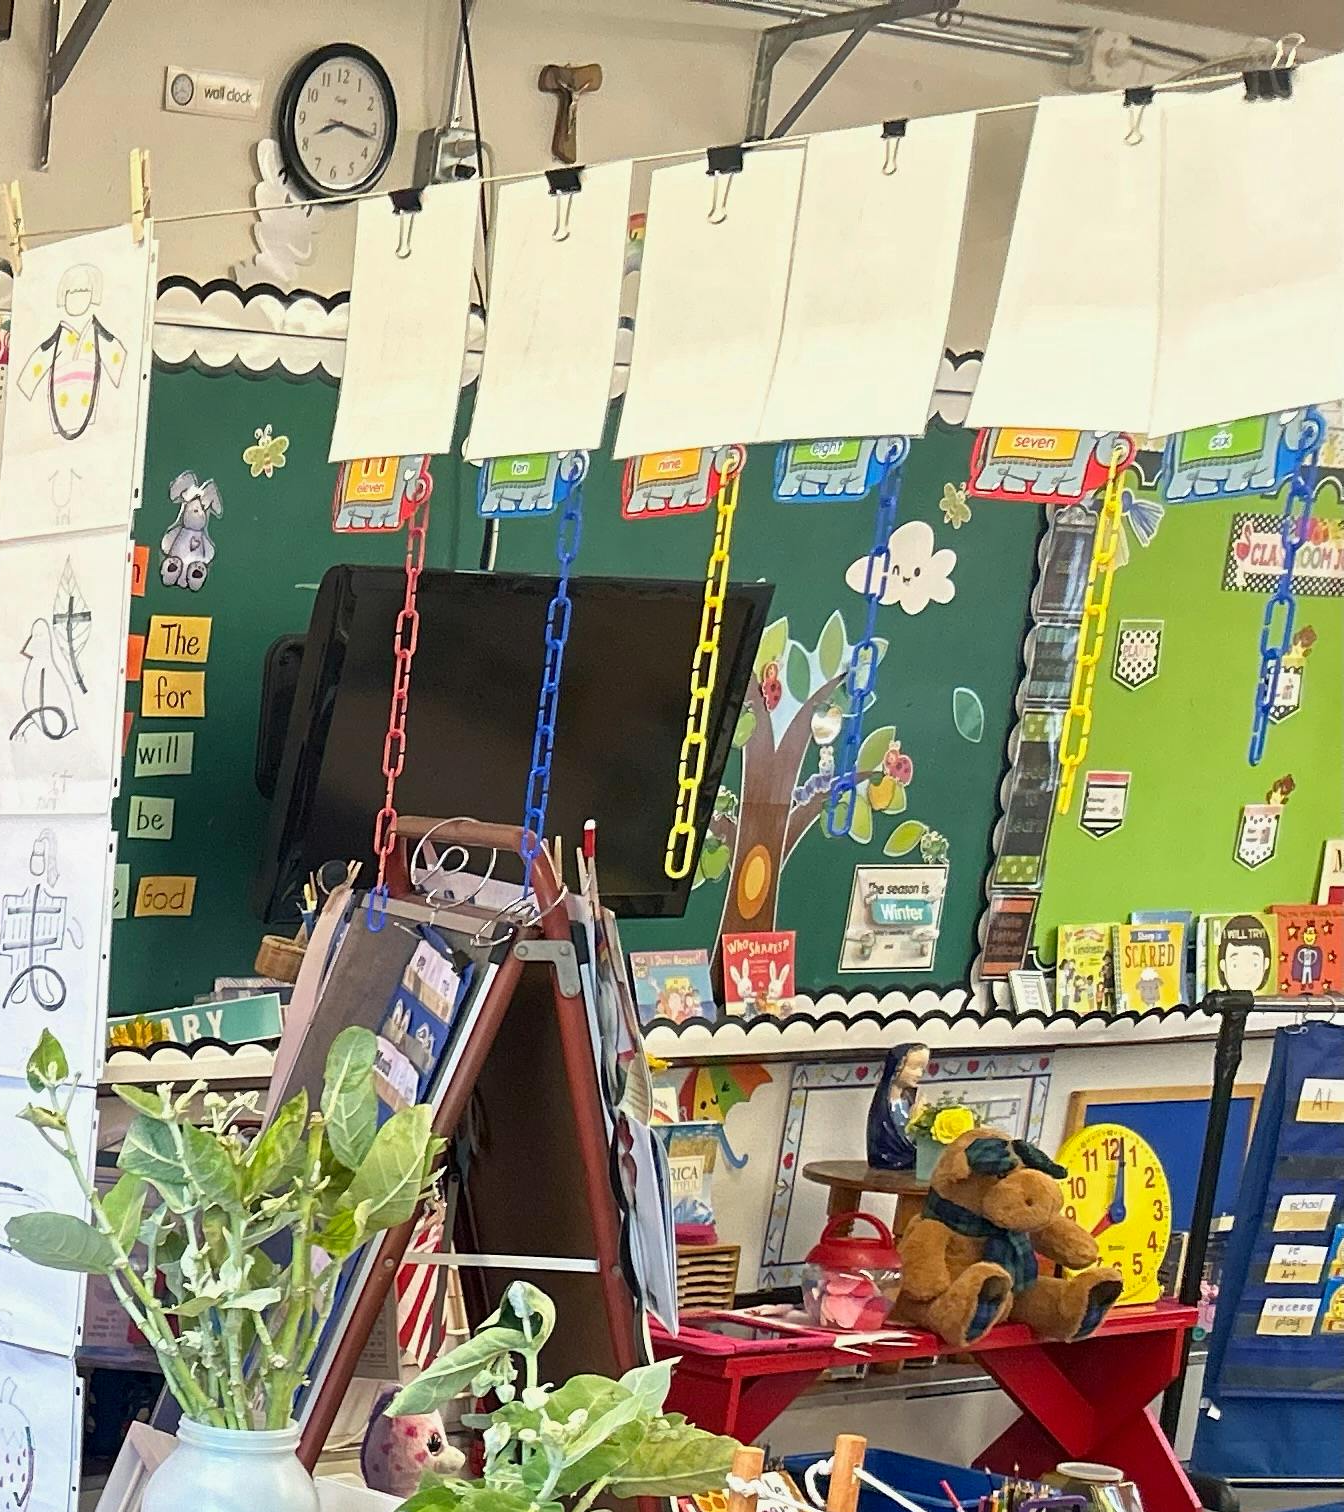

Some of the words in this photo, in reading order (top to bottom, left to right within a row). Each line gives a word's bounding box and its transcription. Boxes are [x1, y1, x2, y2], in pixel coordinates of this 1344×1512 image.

[322, 72, 332, 88] 11
[337, 68, 350, 84] 12
[357, 77, 362, 92] 1
[205, 86, 225, 99] wall
[226, 87, 252, 104] clock
[307, 87, 319, 104] 10
[367, 96, 375, 112] 2
[299, 110, 306, 125] 9
[301, 137, 309, 152] 8
[361, 146, 368, 161] 4
[314, 157, 322, 172] 7
[329, 165, 338, 180] 6
[347, 161, 355, 177] 5
[1014, 434, 1056, 449] seven
[1211, 433, 1232, 448] six
[512, 460, 529, 474] ten
[657, 458, 682, 470] nine
[356, 481, 385, 494] eleven
[160, 622, 201, 657] The
[153, 676, 192, 710] for
[137, 735, 179, 765] will
[137, 801, 165, 831] be
[868, 882, 885, 895] The
[886, 884, 919, 895] season
[921, 882, 930, 895] is
[141, 882, 187, 912] God
[880, 903, 925, 921] Winter
[1227, 928, 1248, 940] WILL
[1124, 943, 1175, 969] SCARED
[1102, 1138, 1119, 1161] 12
[1128, 1145, 1137, 1168] 1
[1082, 1149, 1099, 1173] 11
[1144, 1166, 1155, 1188] 2
[1067, 1176, 1086, 1200] 10
[1152, 1200, 1163, 1222] 3
[1289, 1196, 1325, 1211] school
[1065, 1205, 1077, 1223] 9
[1147, 1231, 1158, 1253] 4
[1132, 1252, 1143, 1275] 5
[1279, 1256, 1308, 1268] Music
[1270, 1301, 1315, 1313] recess
[1274, 1316, 1304, 1334] play
